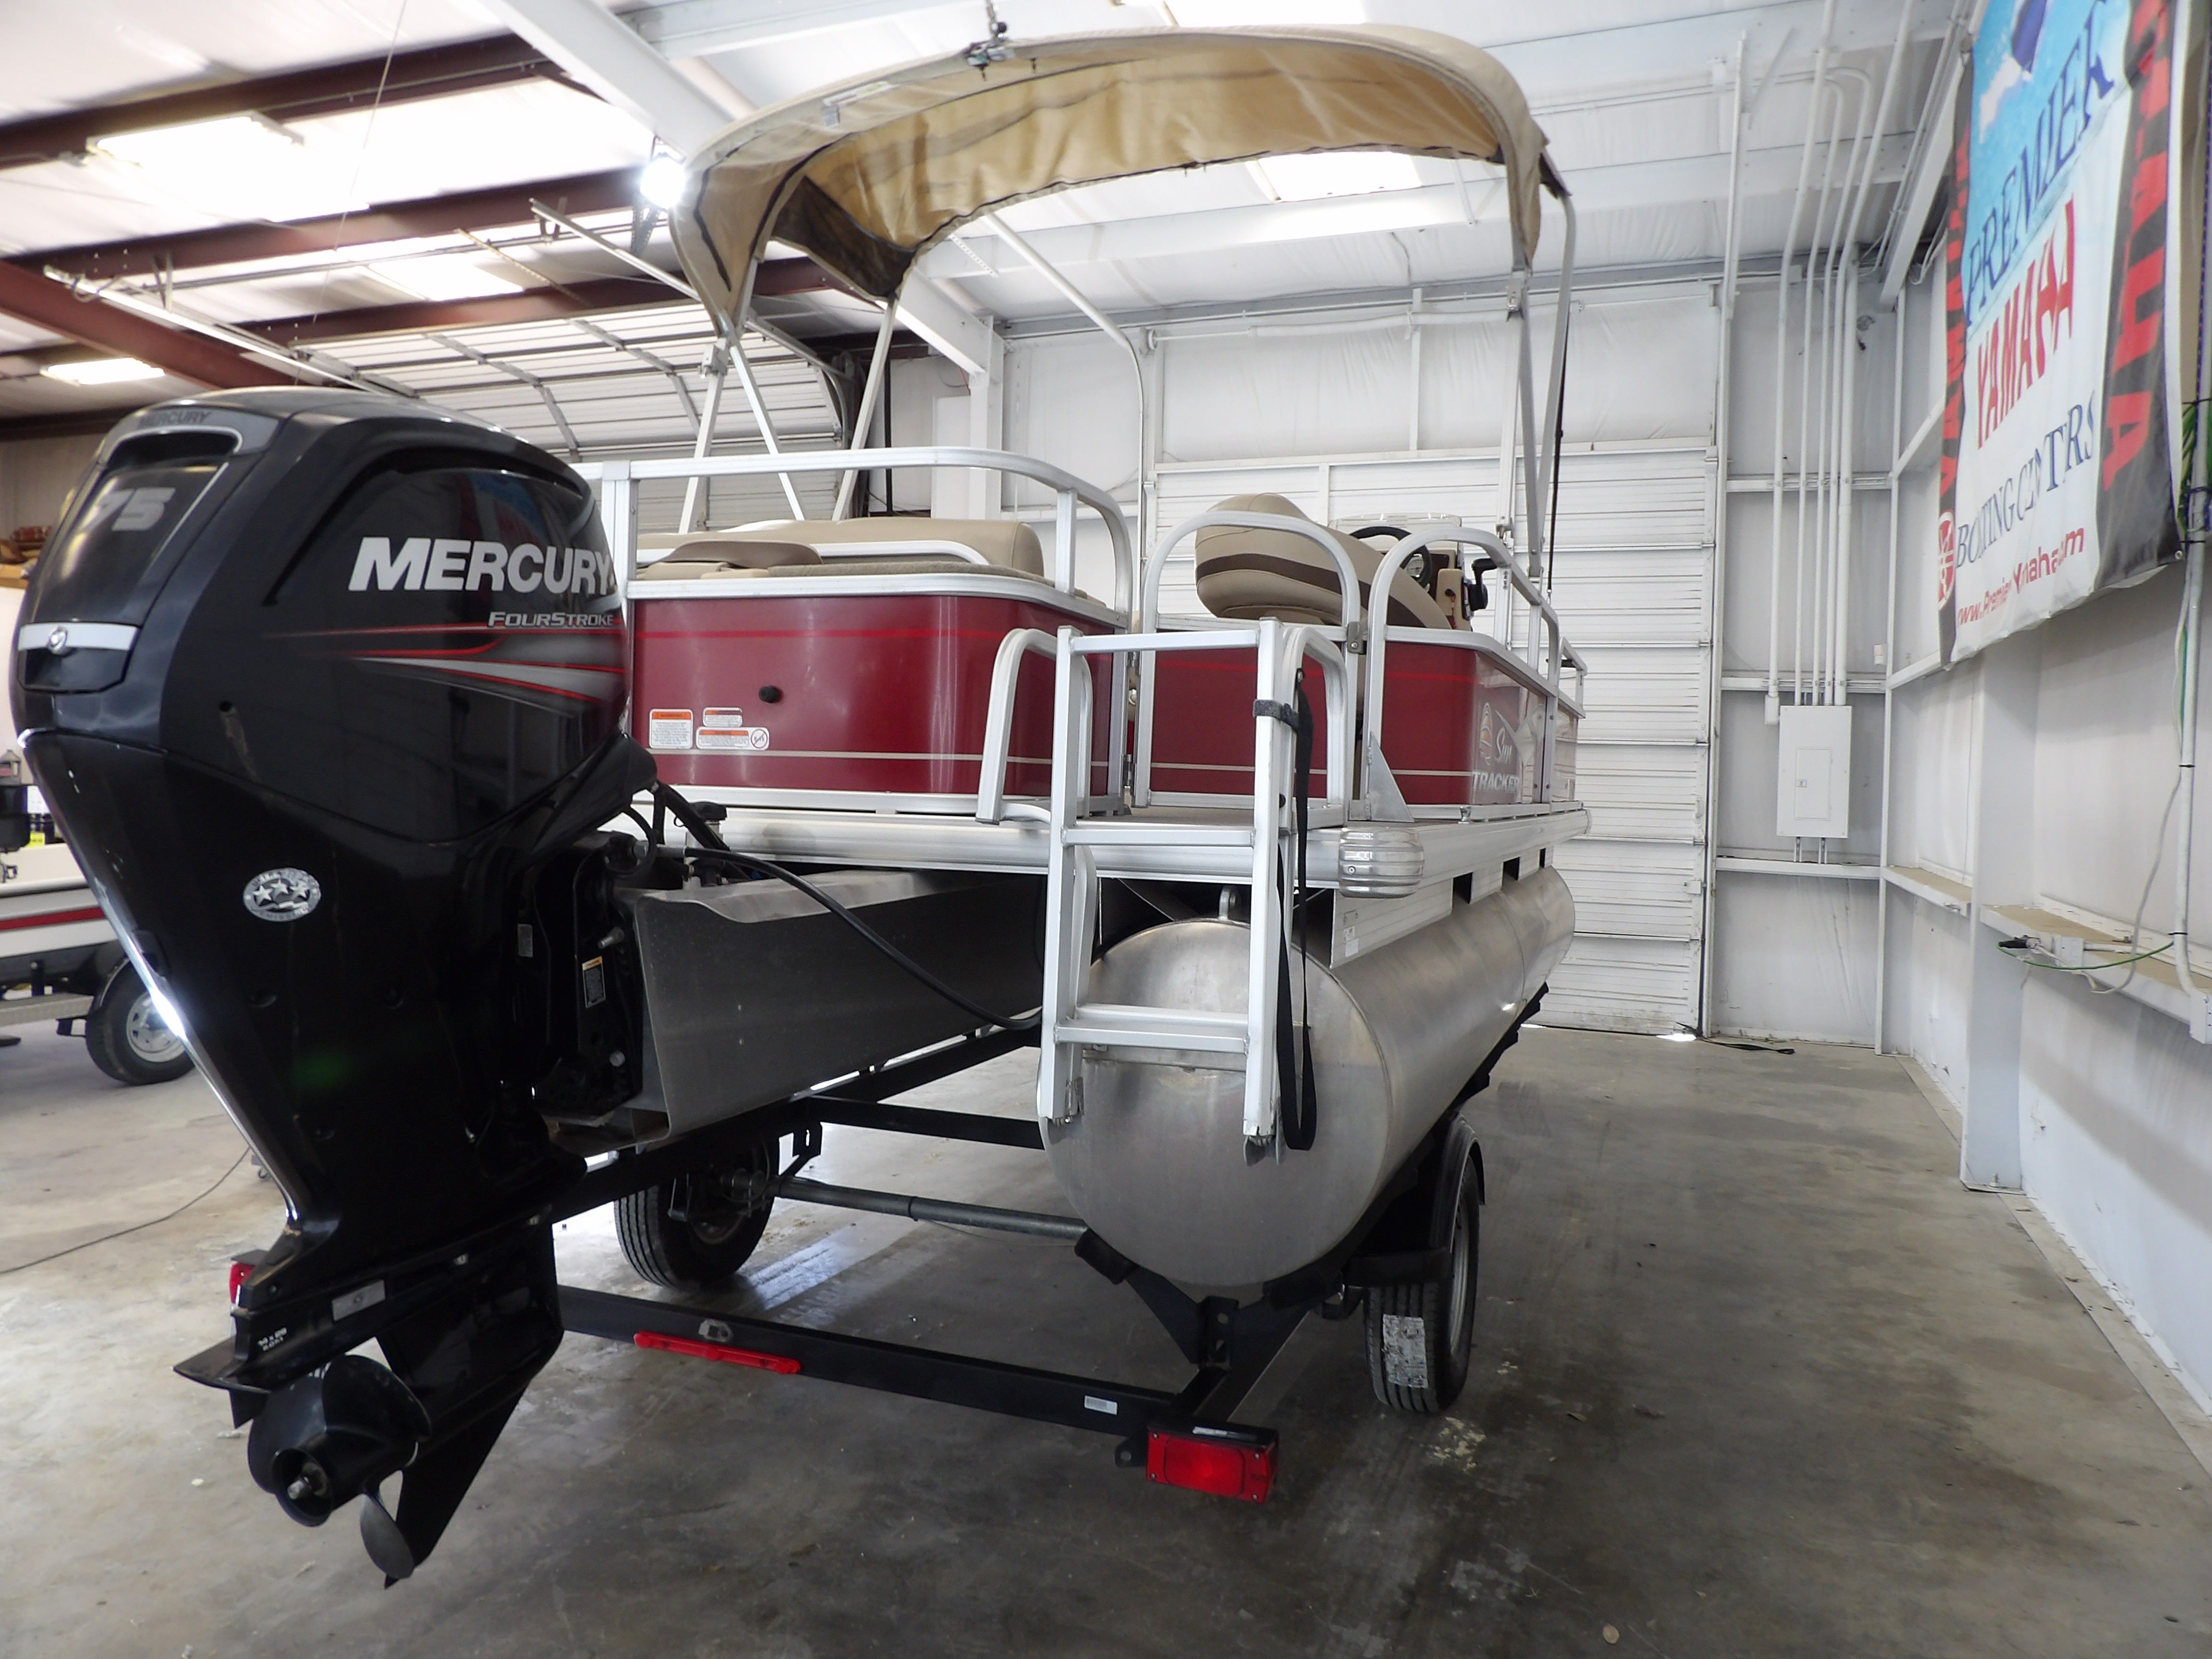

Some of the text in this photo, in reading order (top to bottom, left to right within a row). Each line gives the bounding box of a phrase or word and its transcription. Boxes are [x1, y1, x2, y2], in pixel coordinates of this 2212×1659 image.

[82, 487, 176, 531] 75
[349, 537, 611, 596] MERCURY
[1472, 770, 1519, 793] TRACKER
